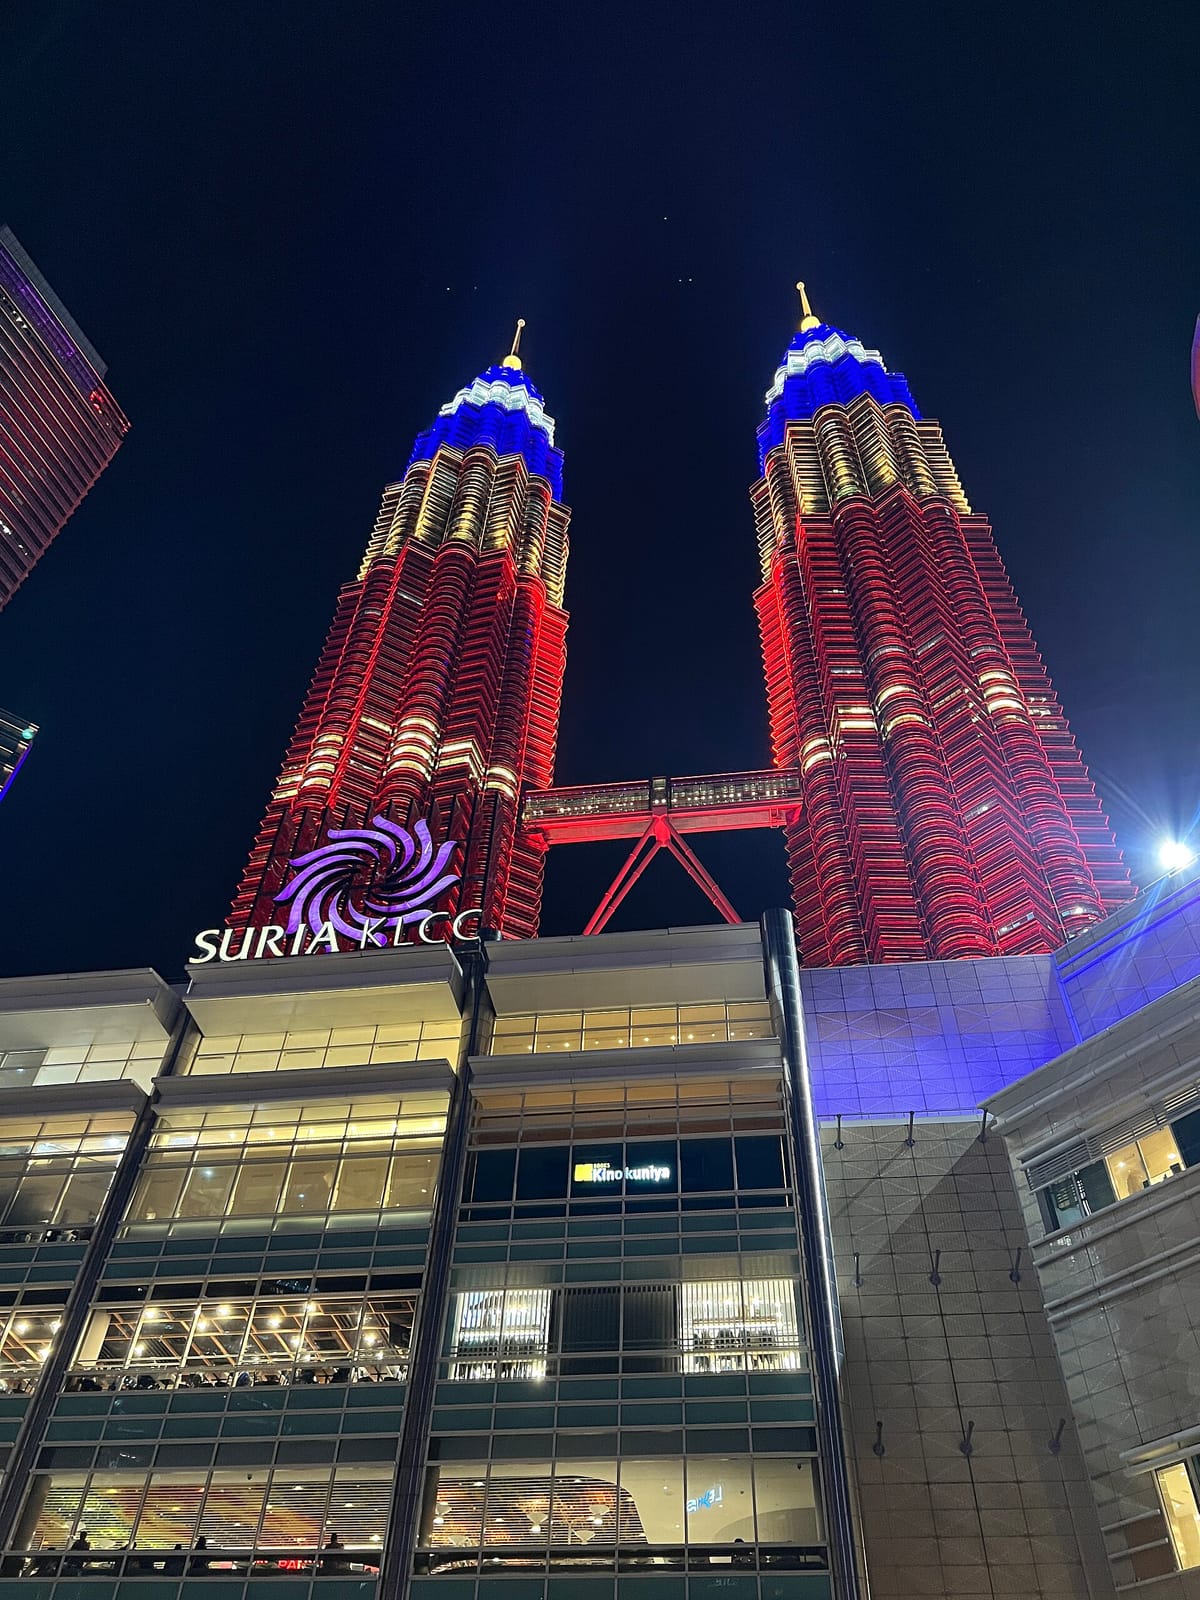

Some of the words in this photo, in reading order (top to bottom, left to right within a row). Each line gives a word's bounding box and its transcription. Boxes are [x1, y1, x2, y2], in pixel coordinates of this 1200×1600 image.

[188, 921, 340, 964] SURIA
[360, 908, 483, 950] KLCC
[592, 1165, 671, 1182] Kinokuniya
